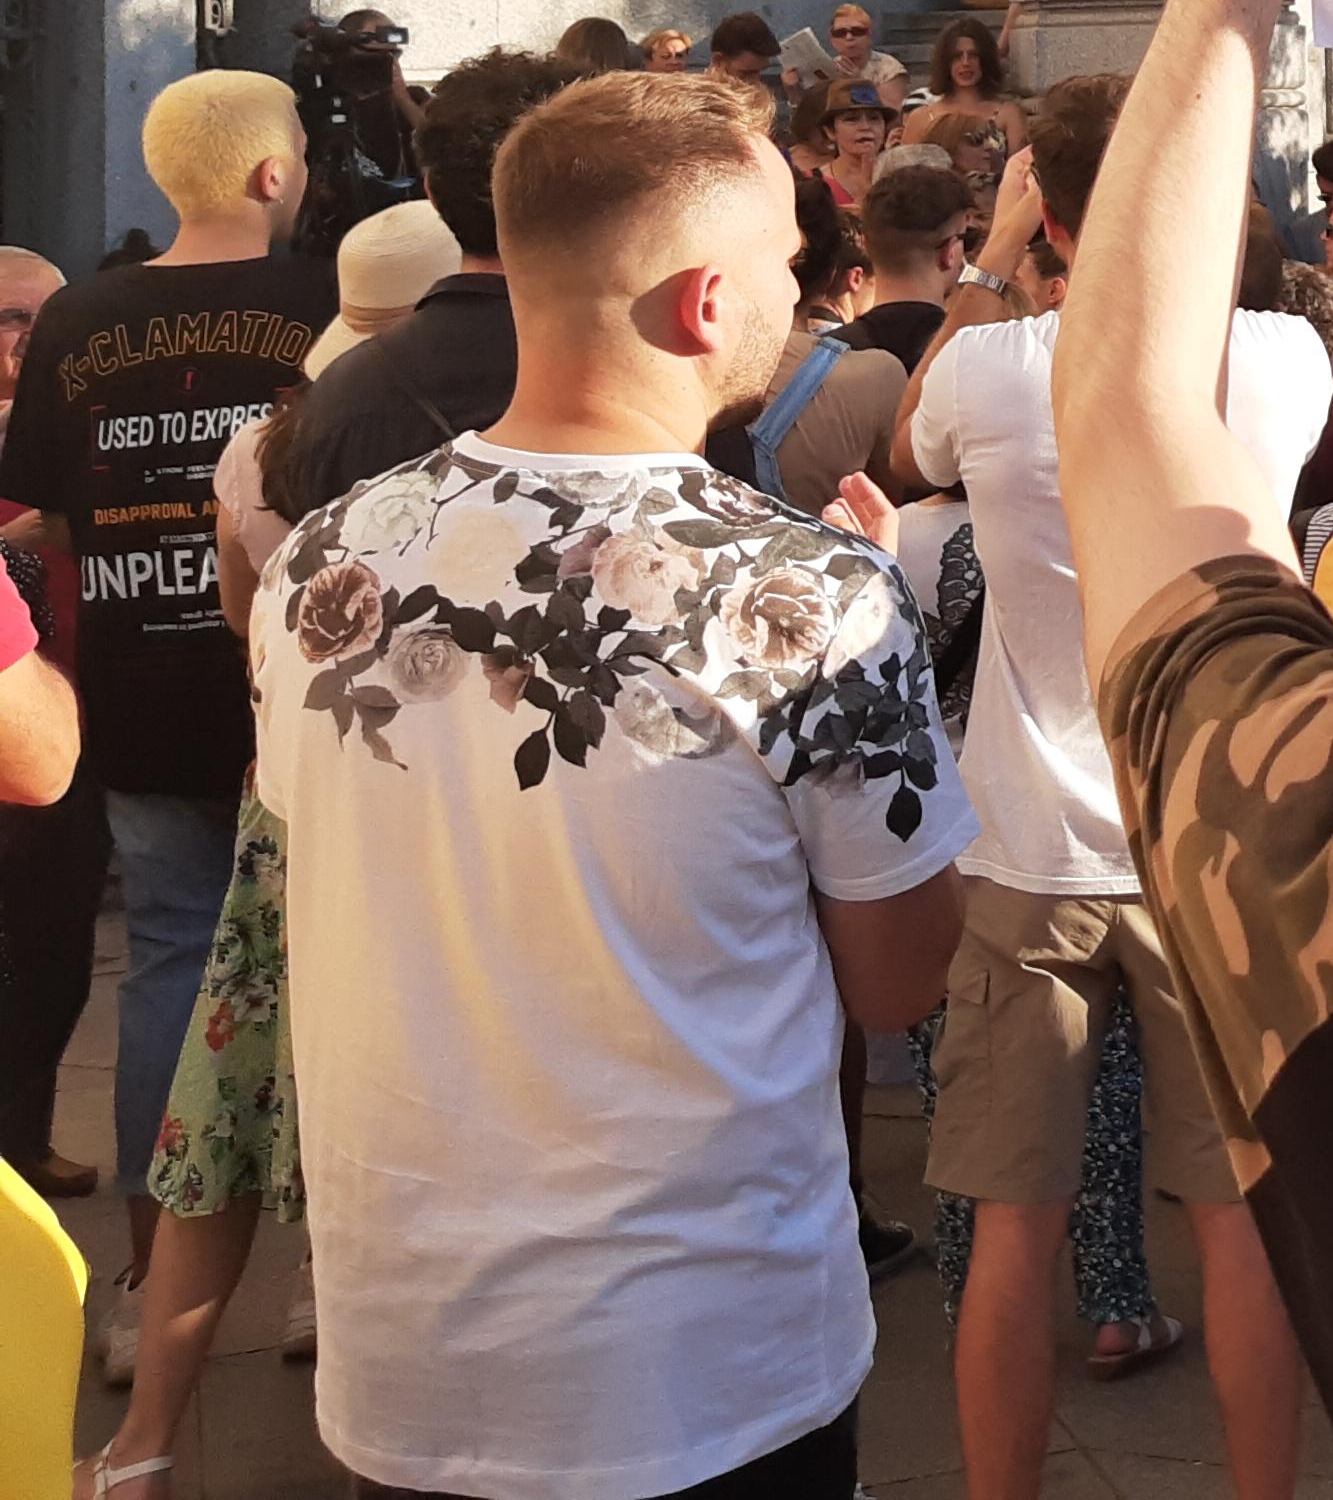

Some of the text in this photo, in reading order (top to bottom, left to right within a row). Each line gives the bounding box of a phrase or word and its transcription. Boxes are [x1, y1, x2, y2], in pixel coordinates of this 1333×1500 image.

[59, 310, 312, 401] X-CLAMATIO
[98, 415, 155, 451] USED
[159, 411, 187, 444] TO
[94, 502, 197, 526] DISAPPROVAL
[81, 546, 220, 601] UNPLEA
